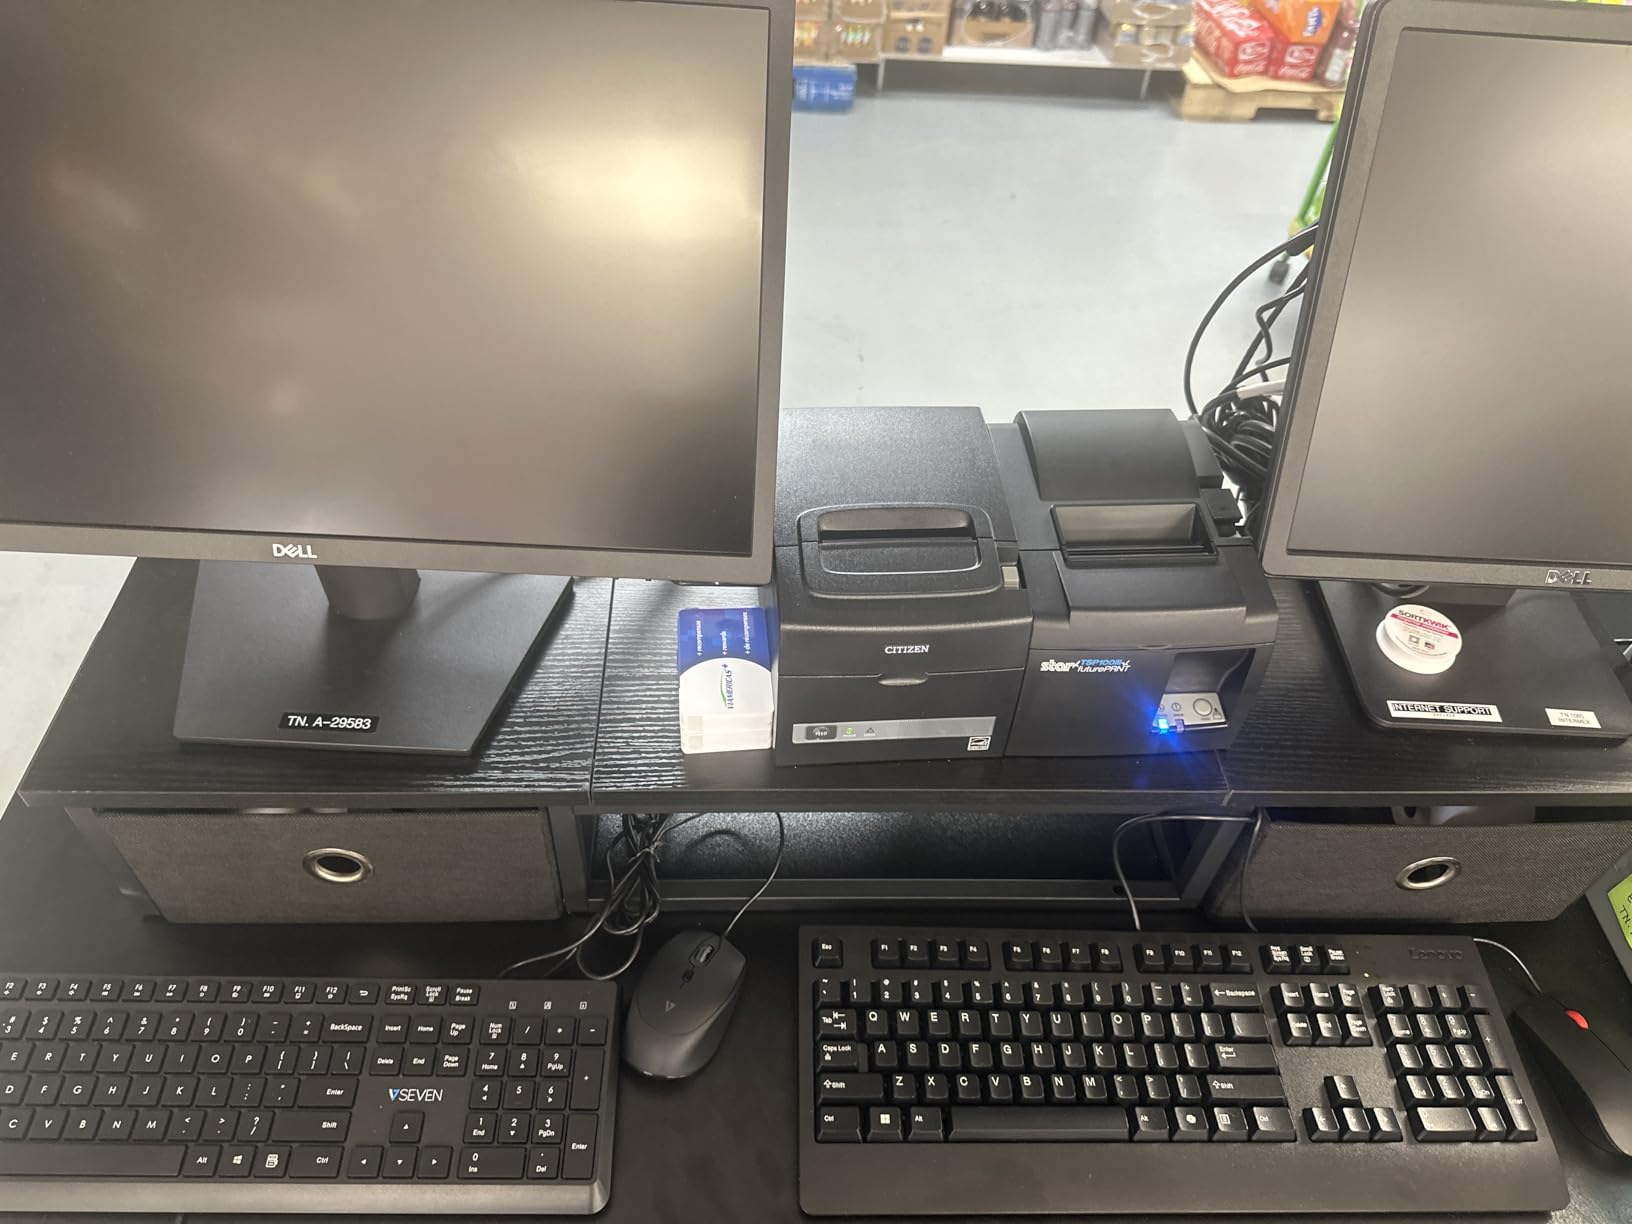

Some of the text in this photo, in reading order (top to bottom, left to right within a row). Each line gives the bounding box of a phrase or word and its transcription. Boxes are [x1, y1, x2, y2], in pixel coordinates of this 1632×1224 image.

[272, 544, 318, 558] DELL
[1545, 570, 1592, 585] DELL
[885, 645, 929, 654] CITIZEN
[1392, 703, 1439, 713] INTERNET
[1444, 705, 1491, 715] SUPPORT
[288, 716, 371, 729] TN. A-29583
[869, 1012, 877, 1021] Q
[900, 1012, 909, 1021] W
[931, 1012, 938, 1021] E
[962, 1013, 969, 1022] R
[992, 1014, 999, 1022] T
[1023, 1014, 1029, 1023] Y
[1053, 1014, 1060, 1023] U
[1113, 1014, 1122, 1024] O
[1144, 1014, 1151, 1024] P
[4, 1025, 11, 1033] 3
[878, 1044, 886, 1052] A
[910, 1044, 916, 1053] S
[941, 1044, 949, 1053] D
[972, 1044, 979, 1053] F
[1003, 1045, 1011, 1054] G
[1034, 1045, 1042, 1053] H
[1066, 1046, 1071, 1055] J
[1095, 1046, 1103, 1056] K
[1126, 1045, 1133, 1056] L
[11, 1052, 18, 1060] E
[80, 1053, 85, 1061] T
[245, 1055, 252, 1063] P
[896, 1076, 903, 1085] Z
[928, 1076, 935, 1085] X
[960, 1077, 968, 1086] C
[992, 1077, 999, 1086] V
[1023, 1077, 1031, 1085] B
[1055, 1077, 1063, 1086] N
[1085, 1077, 1095, 1086] M
[5, 1085, 13, 1093] D
[73, 1086, 82, 1094] G
[109, 1086, 116, 1094] H
[143, 1086, 149, 1094] J
[212, 1087, 216, 1095] L
[517, 1086, 521, 1094] 5
[9, 1119, 18, 1128] C
[45, 1120, 52, 1128] V
[80, 1120, 86, 1128] B
[512, 1118, 517, 1126] 2
[545, 1119, 550, 1127] 3
[473, 1153, 478, 1161] 0
